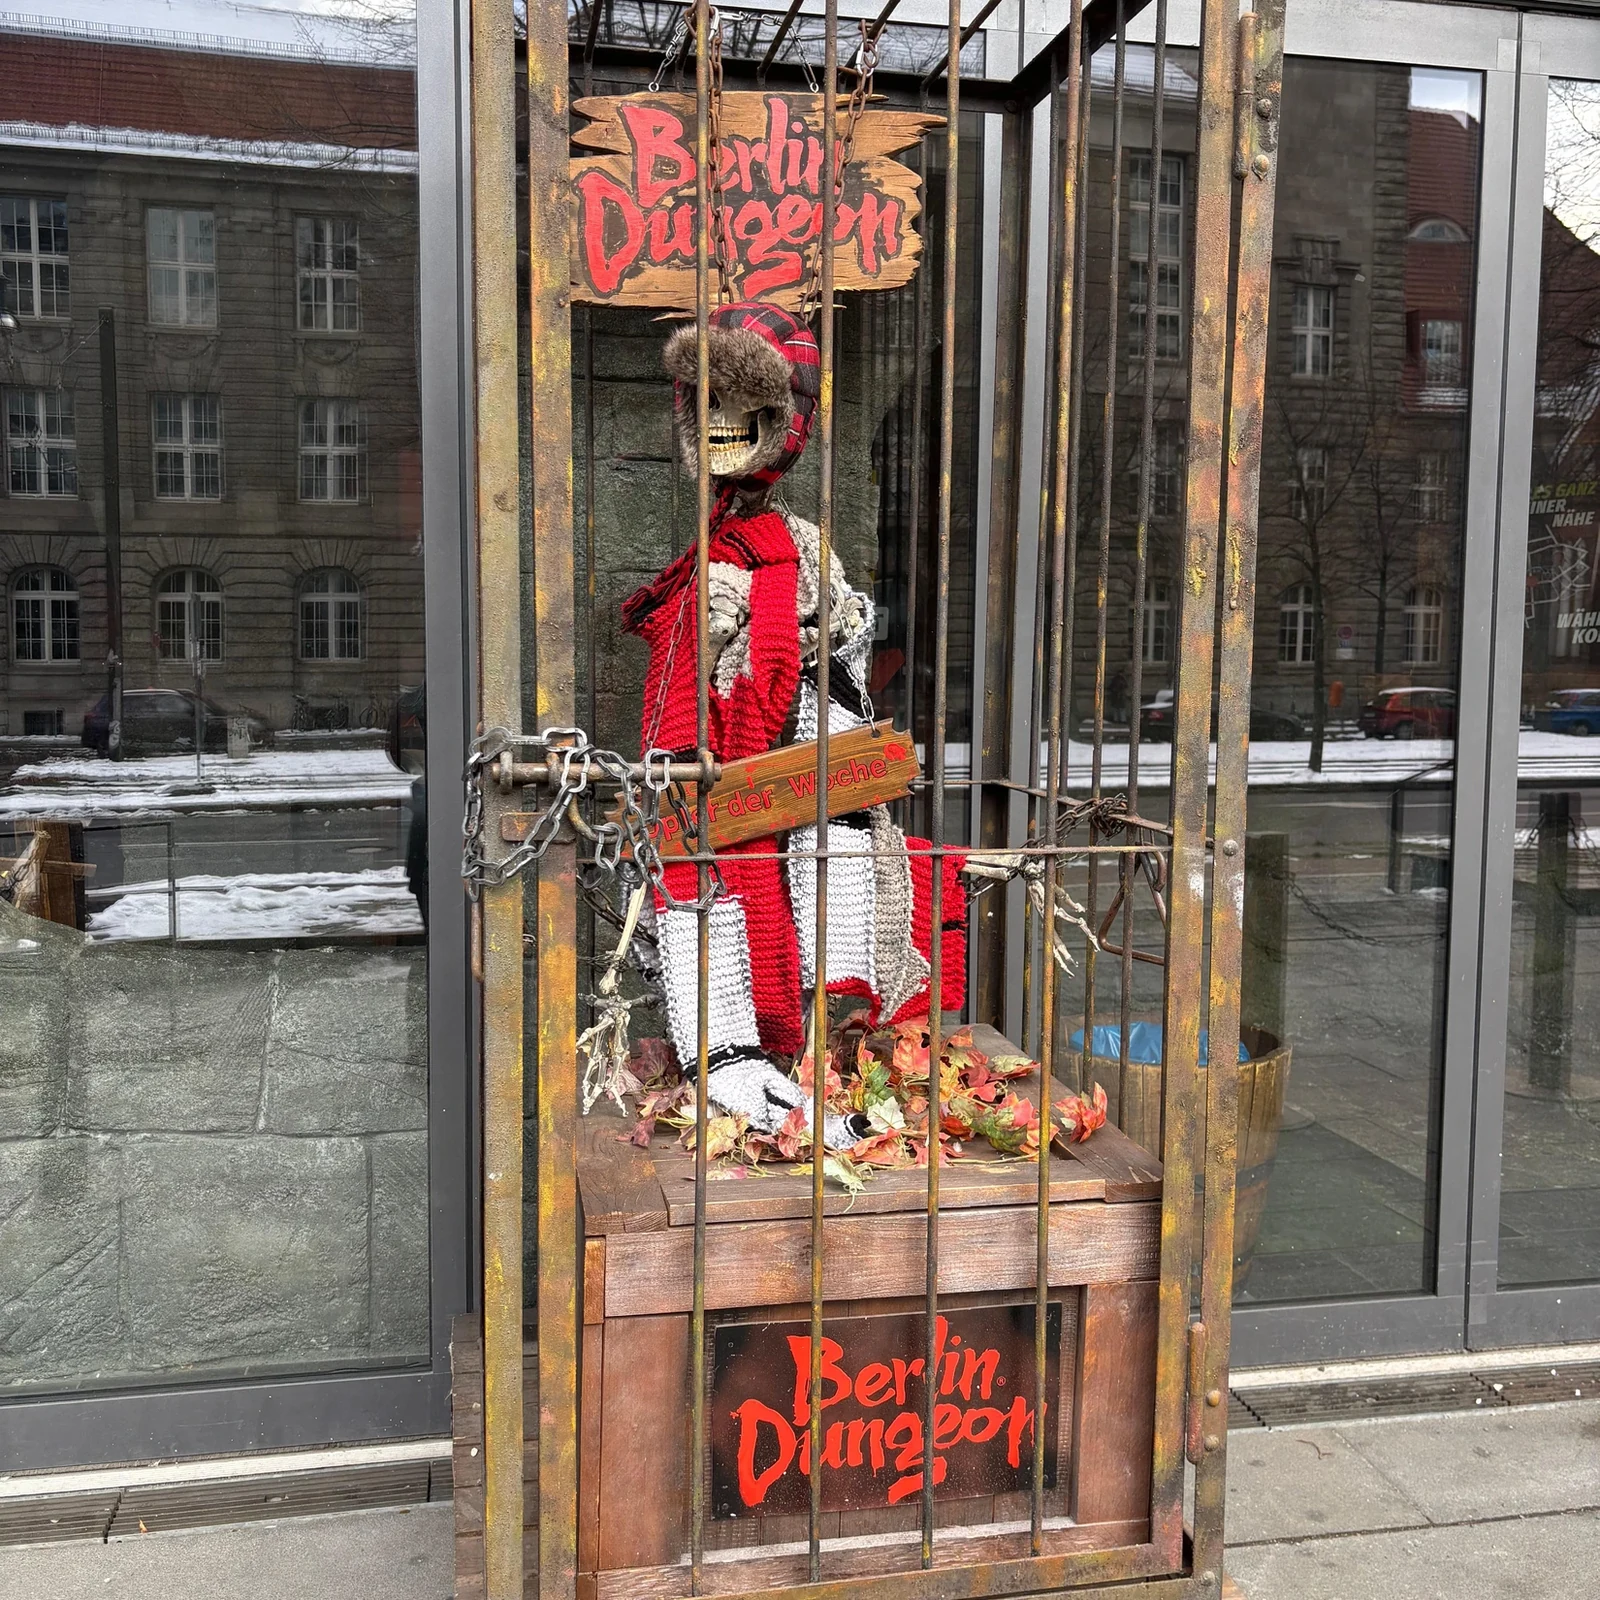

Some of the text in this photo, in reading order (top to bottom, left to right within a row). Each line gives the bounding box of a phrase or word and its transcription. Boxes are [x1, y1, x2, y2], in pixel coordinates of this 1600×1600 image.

[621, 97, 843, 207] Berlin
[578, 171, 898, 300] Dungeon
[1551, 509, 1595, 528] NÄHE
[1555, 481, 1597, 498] GANZ
[1571, 627, 1600, 644] KO
[728, 790, 773, 818] der
[786, 1315, 1000, 1426] Berlin
[730, 1395, 1048, 1507] Dungeon
